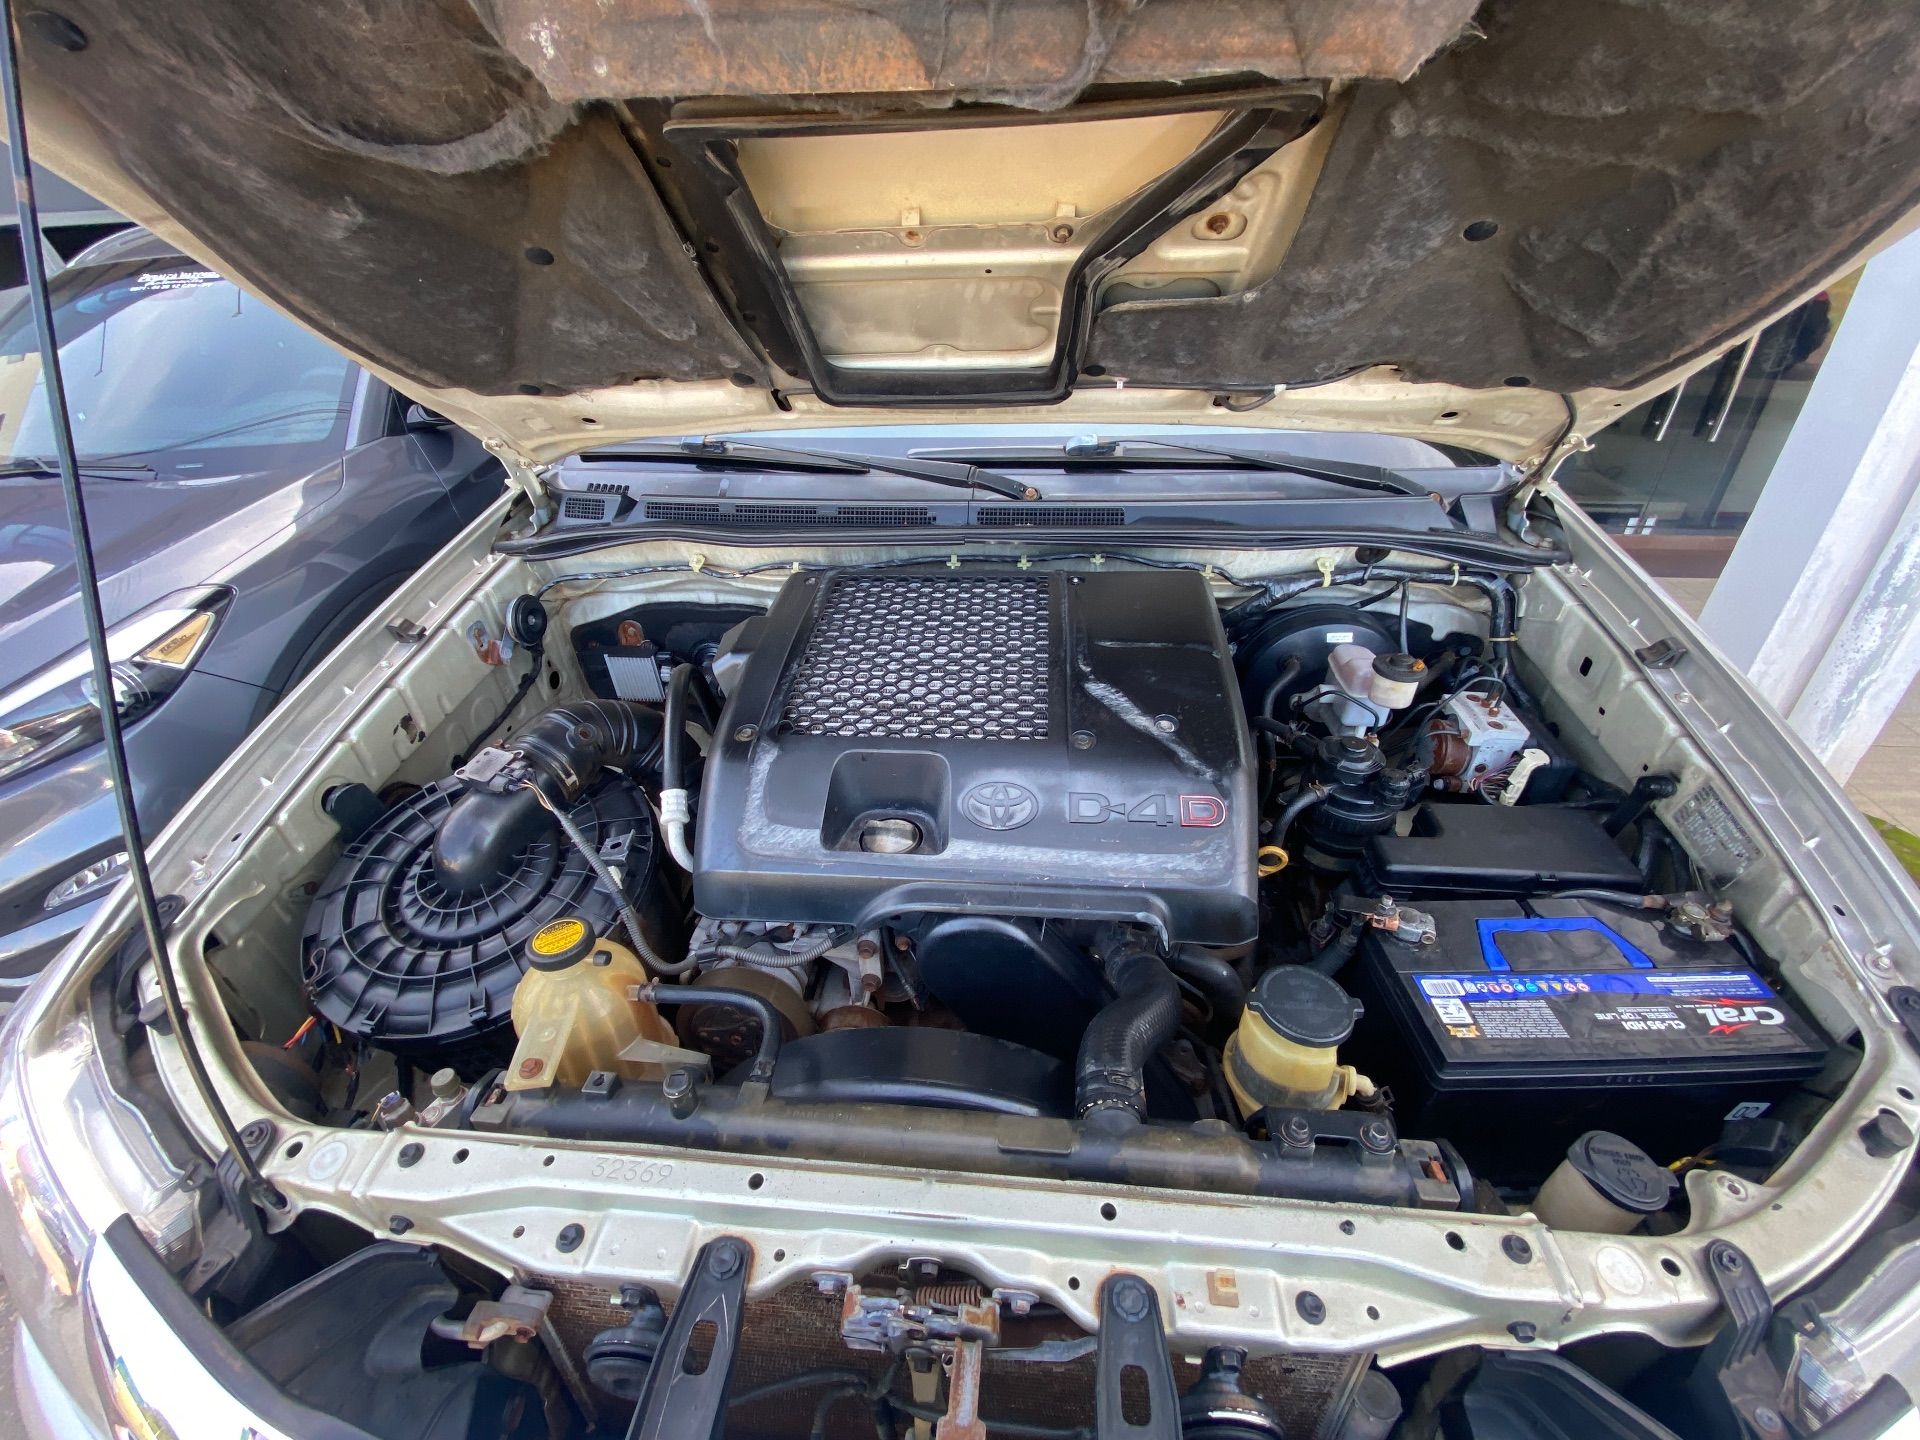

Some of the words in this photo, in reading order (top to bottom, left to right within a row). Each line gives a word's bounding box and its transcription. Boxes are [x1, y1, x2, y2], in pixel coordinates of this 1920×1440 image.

[1068, 791, 1227, 828] D-4D
[1620, 1012, 1642, 1020] TOP
[1621, 1020, 1649, 1031] HDI
[1646, 1020, 1686, 1030] CL-95
[591, 1157, 673, 1184] 32369
